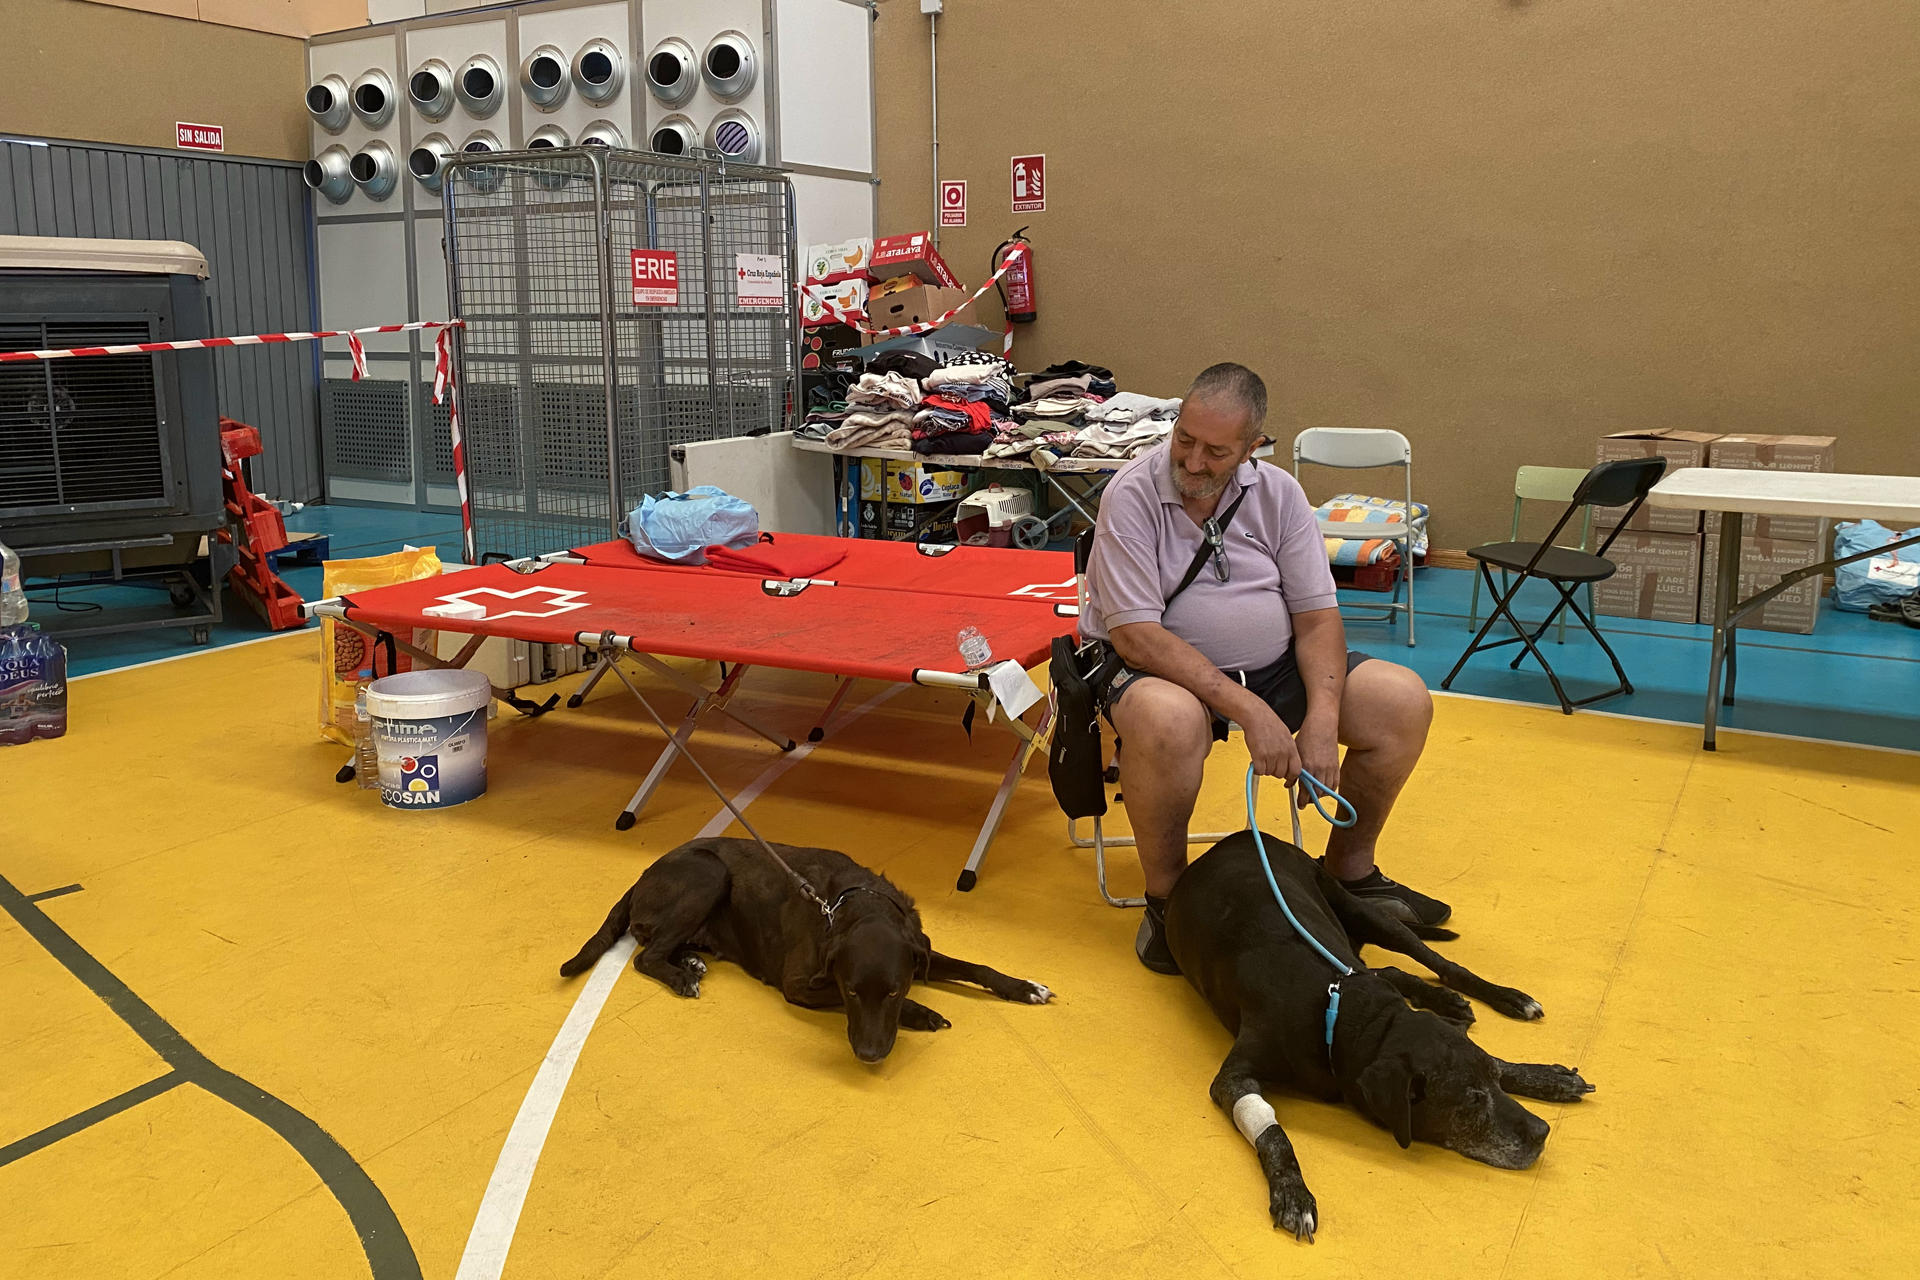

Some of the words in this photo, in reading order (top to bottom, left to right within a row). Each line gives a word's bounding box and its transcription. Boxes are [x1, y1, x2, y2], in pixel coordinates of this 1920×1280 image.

[179, 128, 193, 142] SIN
[194, 130, 221, 146] SALIDA
[1015, 203, 1042, 211] EXTINTOR
[634, 257, 676, 281] ERIE
[747, 269, 756, 277] Cruz
[756, 269, 765, 279] Roja
[738, 296, 783, 305] EMERGENCIAS
[1657, 584, 1685, 594] LUED
[1772, 595, 1801, 604] LUED
[0, 668, 39, 681] DEUS
